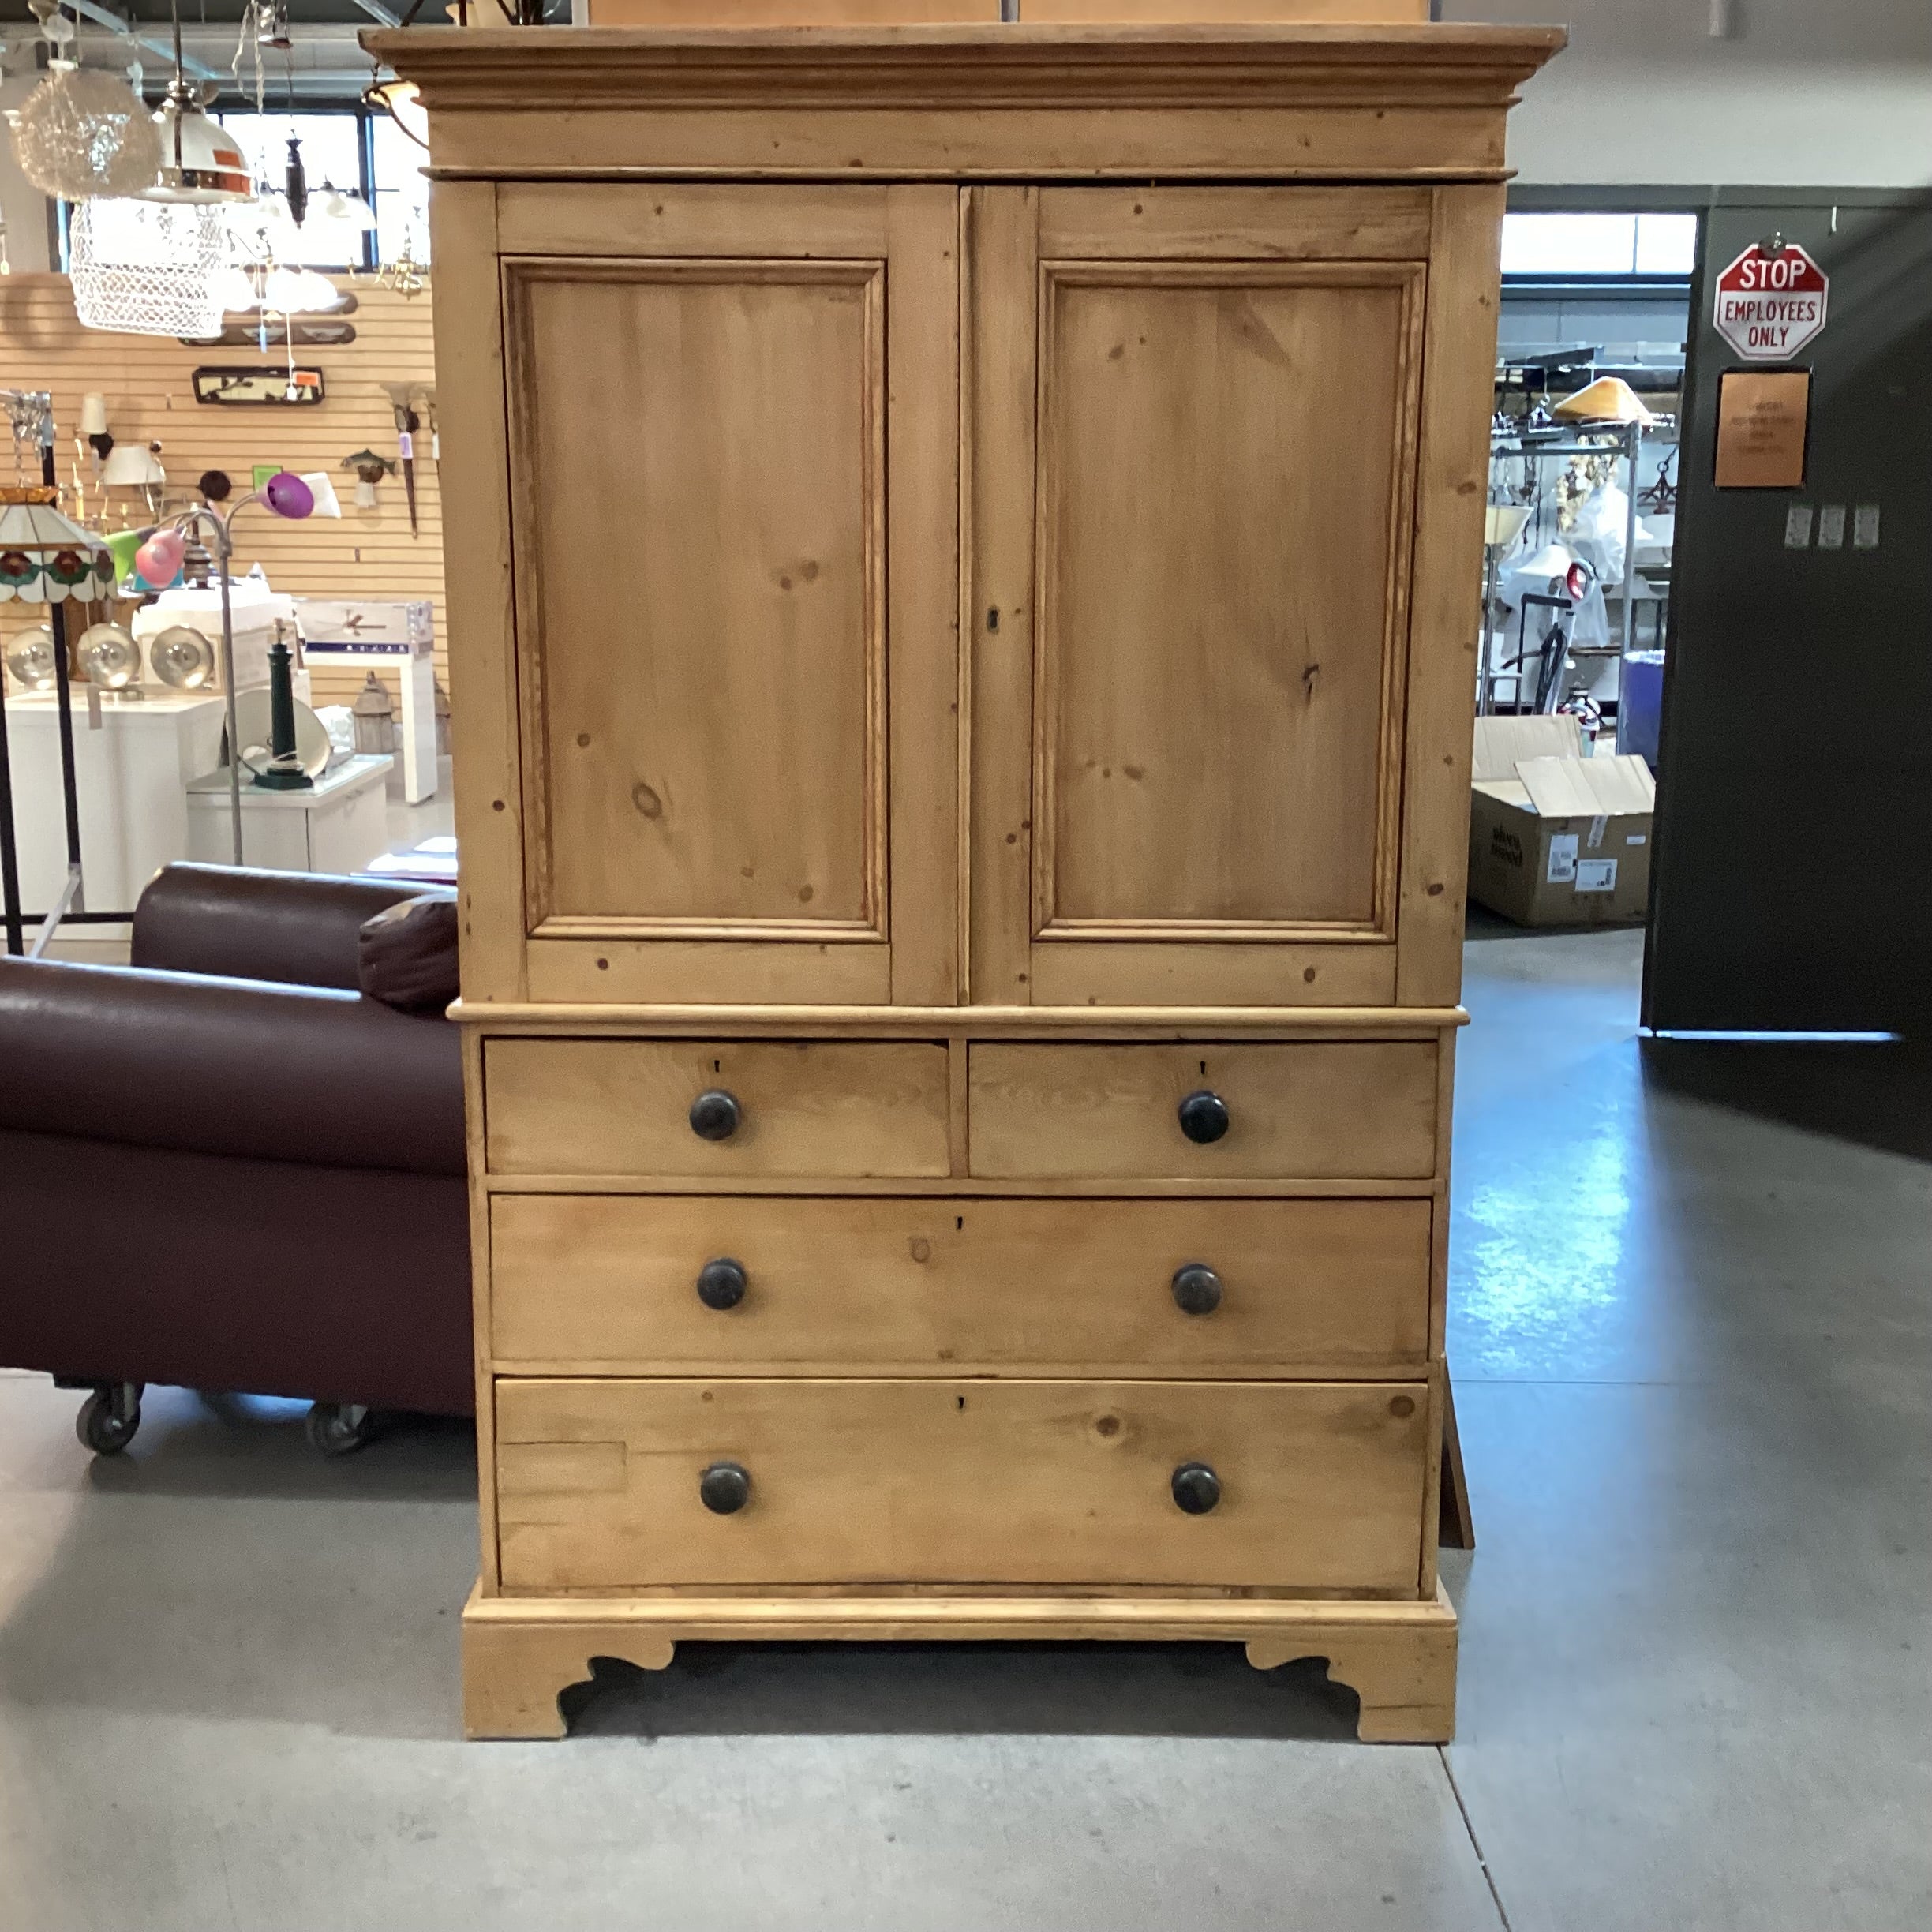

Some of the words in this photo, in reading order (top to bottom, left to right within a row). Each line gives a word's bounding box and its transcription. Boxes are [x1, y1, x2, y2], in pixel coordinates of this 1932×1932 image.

[1739, 258, 1807, 289] STOP
[1724, 300, 1817, 321] EMPLOYEES
[1748, 326, 1789, 347] ONLY
